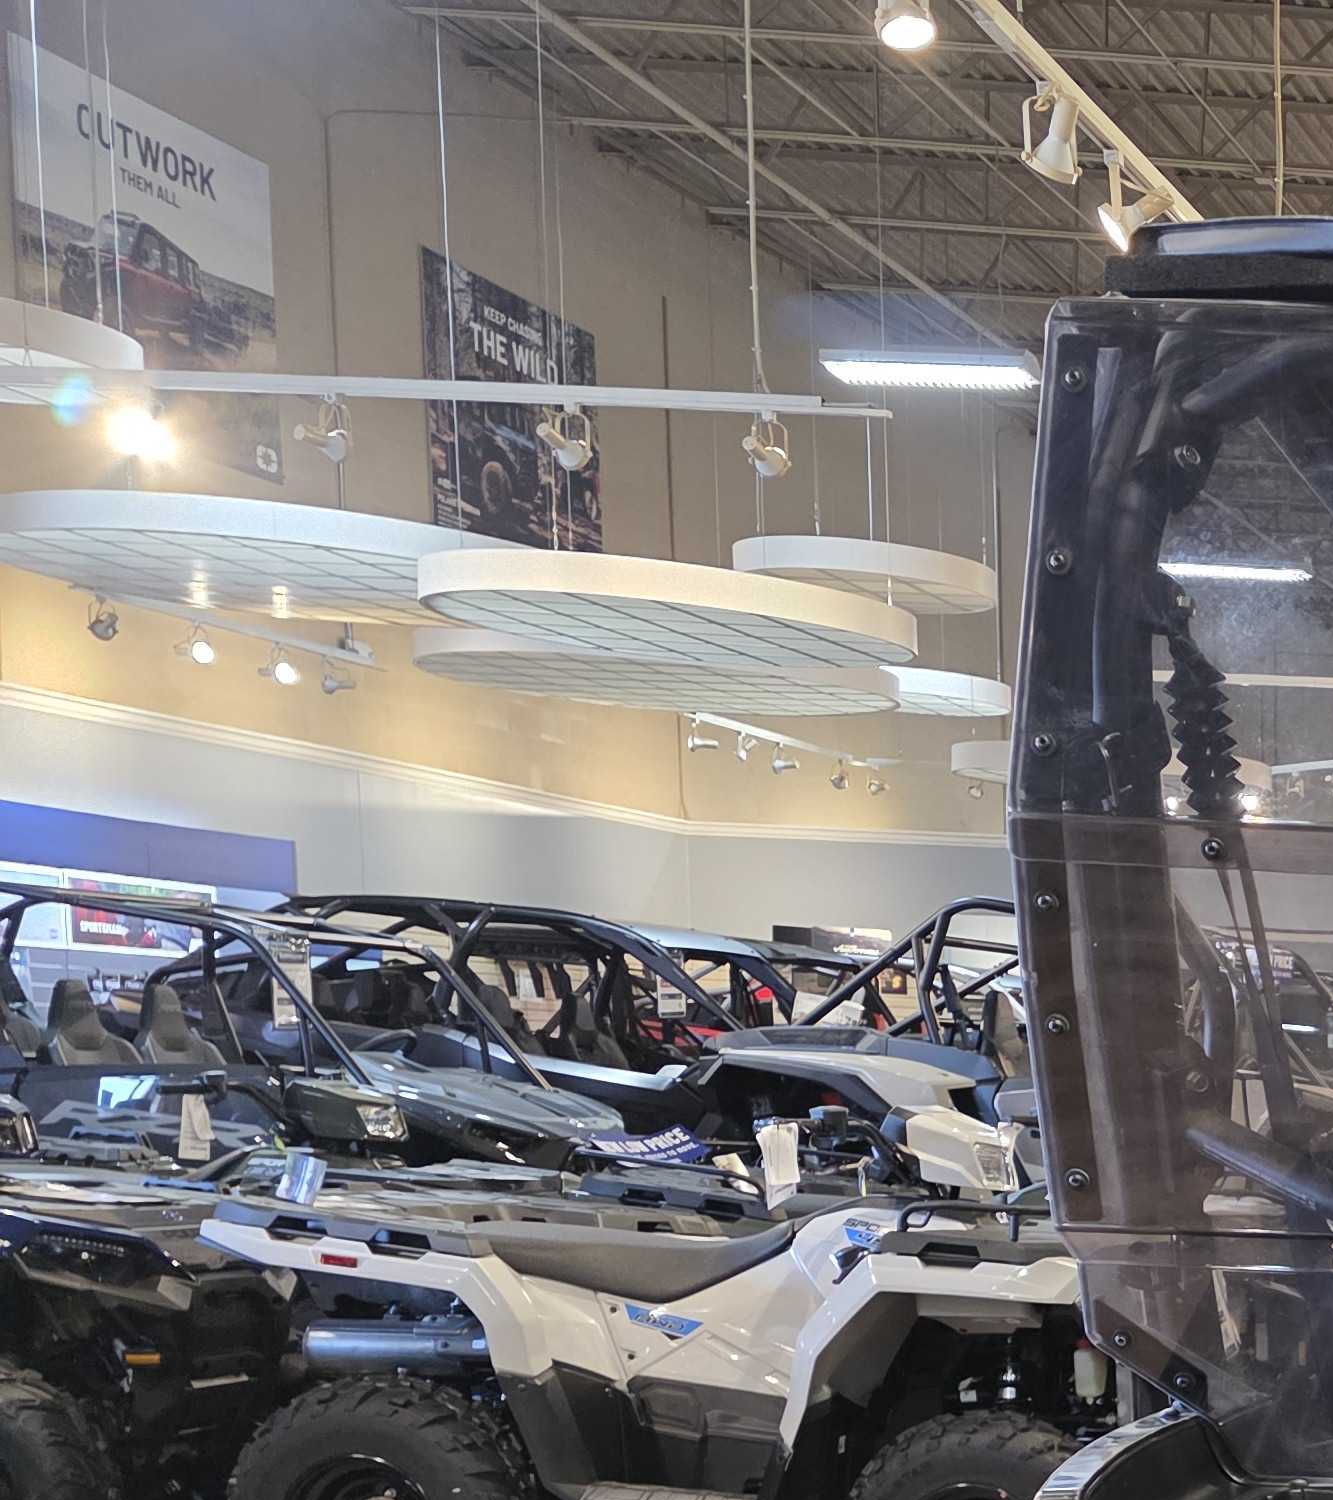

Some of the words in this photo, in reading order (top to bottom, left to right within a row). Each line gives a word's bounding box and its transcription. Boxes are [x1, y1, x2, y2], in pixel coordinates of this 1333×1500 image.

[119, 167, 154, 197] THEM
[483, 304, 507, 327] KEEP
[469, 320, 509, 366] THE
[511, 341, 558, 385] WILD
[643, 1126, 691, 1153] PRICE
